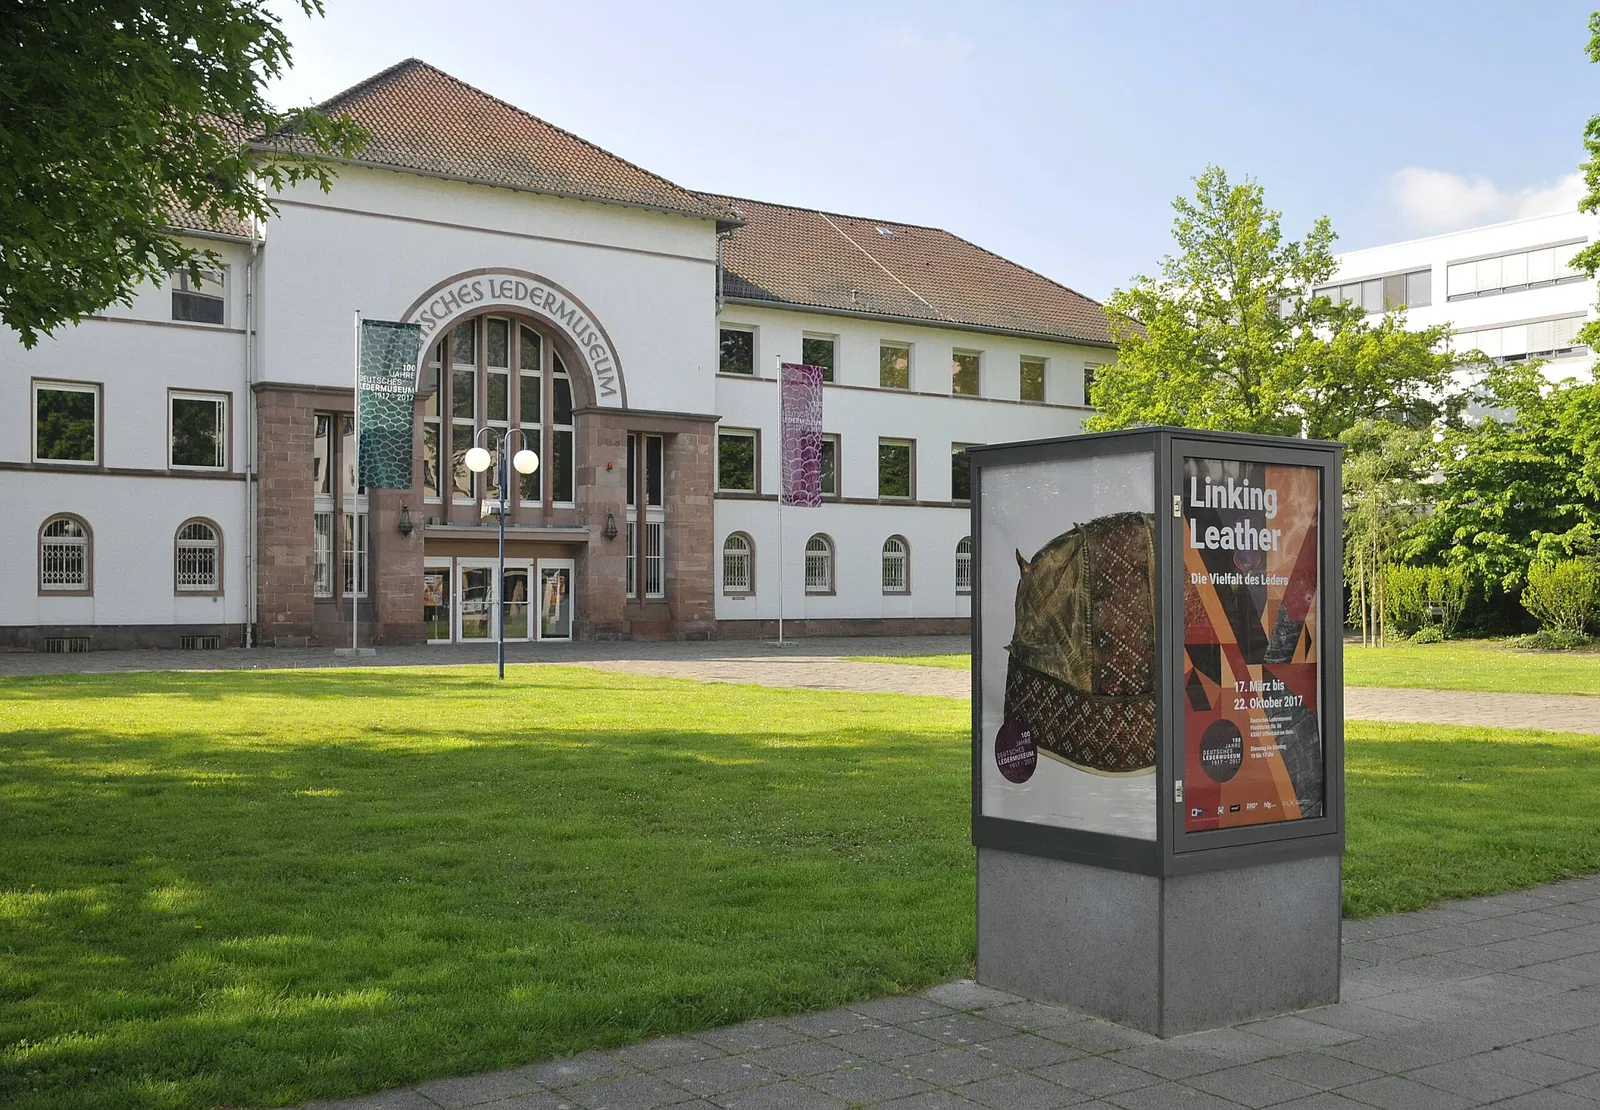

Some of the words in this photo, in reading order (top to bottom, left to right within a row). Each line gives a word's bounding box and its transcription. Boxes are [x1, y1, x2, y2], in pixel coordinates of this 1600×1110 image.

[488, 279, 617, 397] LEDERMUSEUM
[403, 364, 416, 372] 100
[390, 371, 415, 379] JAHRE
[374, 391, 390, 400] 1917
[397, 393, 414, 401] 2017
[1190, 476, 1278, 519] Linking
[1190, 518, 1282, 552] Leather
[1191, 573, 1207, 584] Die
[1209, 572, 1243, 585] Vielfalt
[1244, 573, 1260, 585] des
[1261, 574, 1289, 585] Leders
[1234, 681, 1248, 692] 17.
[1249, 680, 1271, 692] März
[1272, 679, 1285, 691] bis
[1233, 698, 1248, 710] 22.
[1249, 696, 1283, 709] Oktober
[1284, 695, 1303, 707] 2017
[1021, 730, 1031, 738] 100
[1016, 737, 1031, 747] JAHRE
[997, 746, 1025, 760] DEUTSCHES
[998, 751, 1034, 766] LEDERMUSEUM
[1202, 753, 1241, 761] LEDERMUSEUM
[1203, 748, 1233, 756] DEUTSCHES
